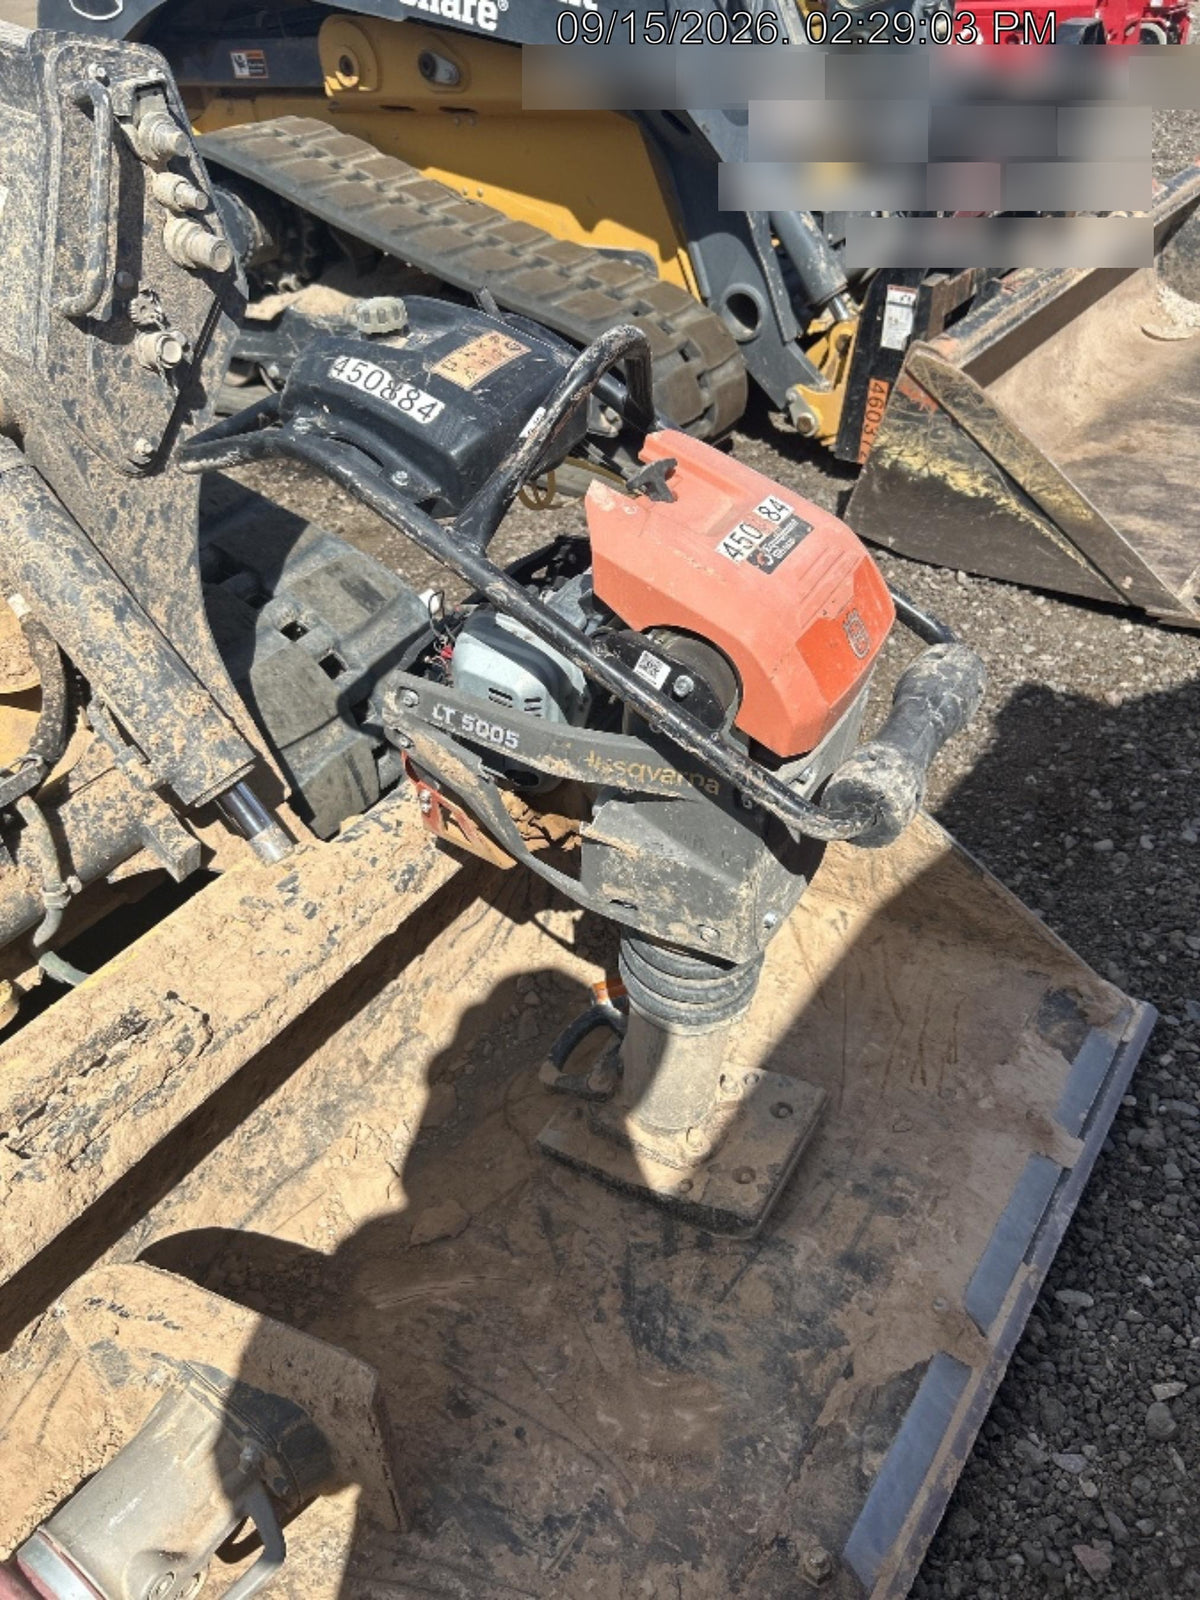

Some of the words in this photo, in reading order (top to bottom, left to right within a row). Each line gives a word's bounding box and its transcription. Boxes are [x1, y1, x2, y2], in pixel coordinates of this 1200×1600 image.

[861, 382, 885, 458] 4603
[432, 703, 456, 724] LT
[461, 714, 520, 749] 5005
